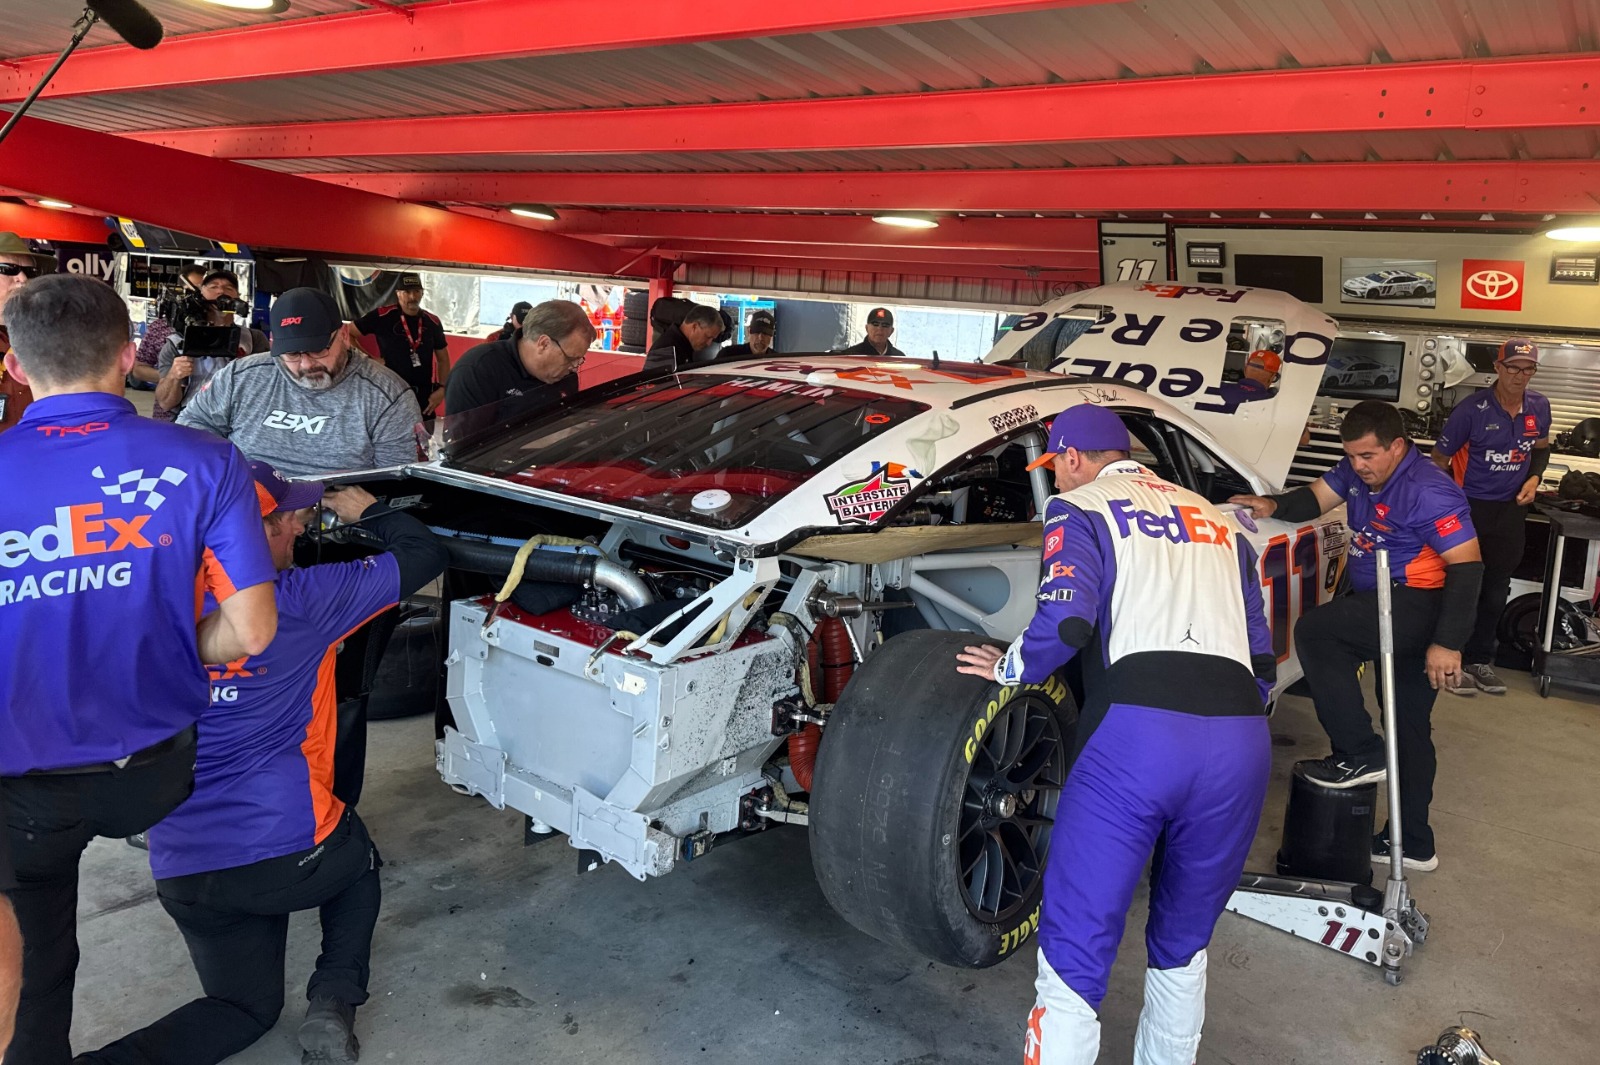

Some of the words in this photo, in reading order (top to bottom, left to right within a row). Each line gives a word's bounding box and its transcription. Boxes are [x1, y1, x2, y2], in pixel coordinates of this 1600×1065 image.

[66, 253, 114, 281] ally
[1117, 258, 1157, 282] 11
[1139, 284, 1247, 304] FedEx
[37, 422, 109, 437] TRD
[1485, 449, 1527, 464] FedEx
[1489, 463, 1521, 472] RACING
[833, 486, 906, 506] INTERSTATE
[1131, 480, 1177, 493] TRD
[842, 499, 901, 517] BATTERI
[0, 502, 154, 568] edEx
[1107, 498, 1232, 550] FedEx
[1040, 561, 1076, 587] dEx
[1260, 525, 1320, 665] 11
[964, 674, 1067, 764] GOODAR
[998, 899, 1043, 955] AGLE
[1319, 919, 1365, 955] 11
